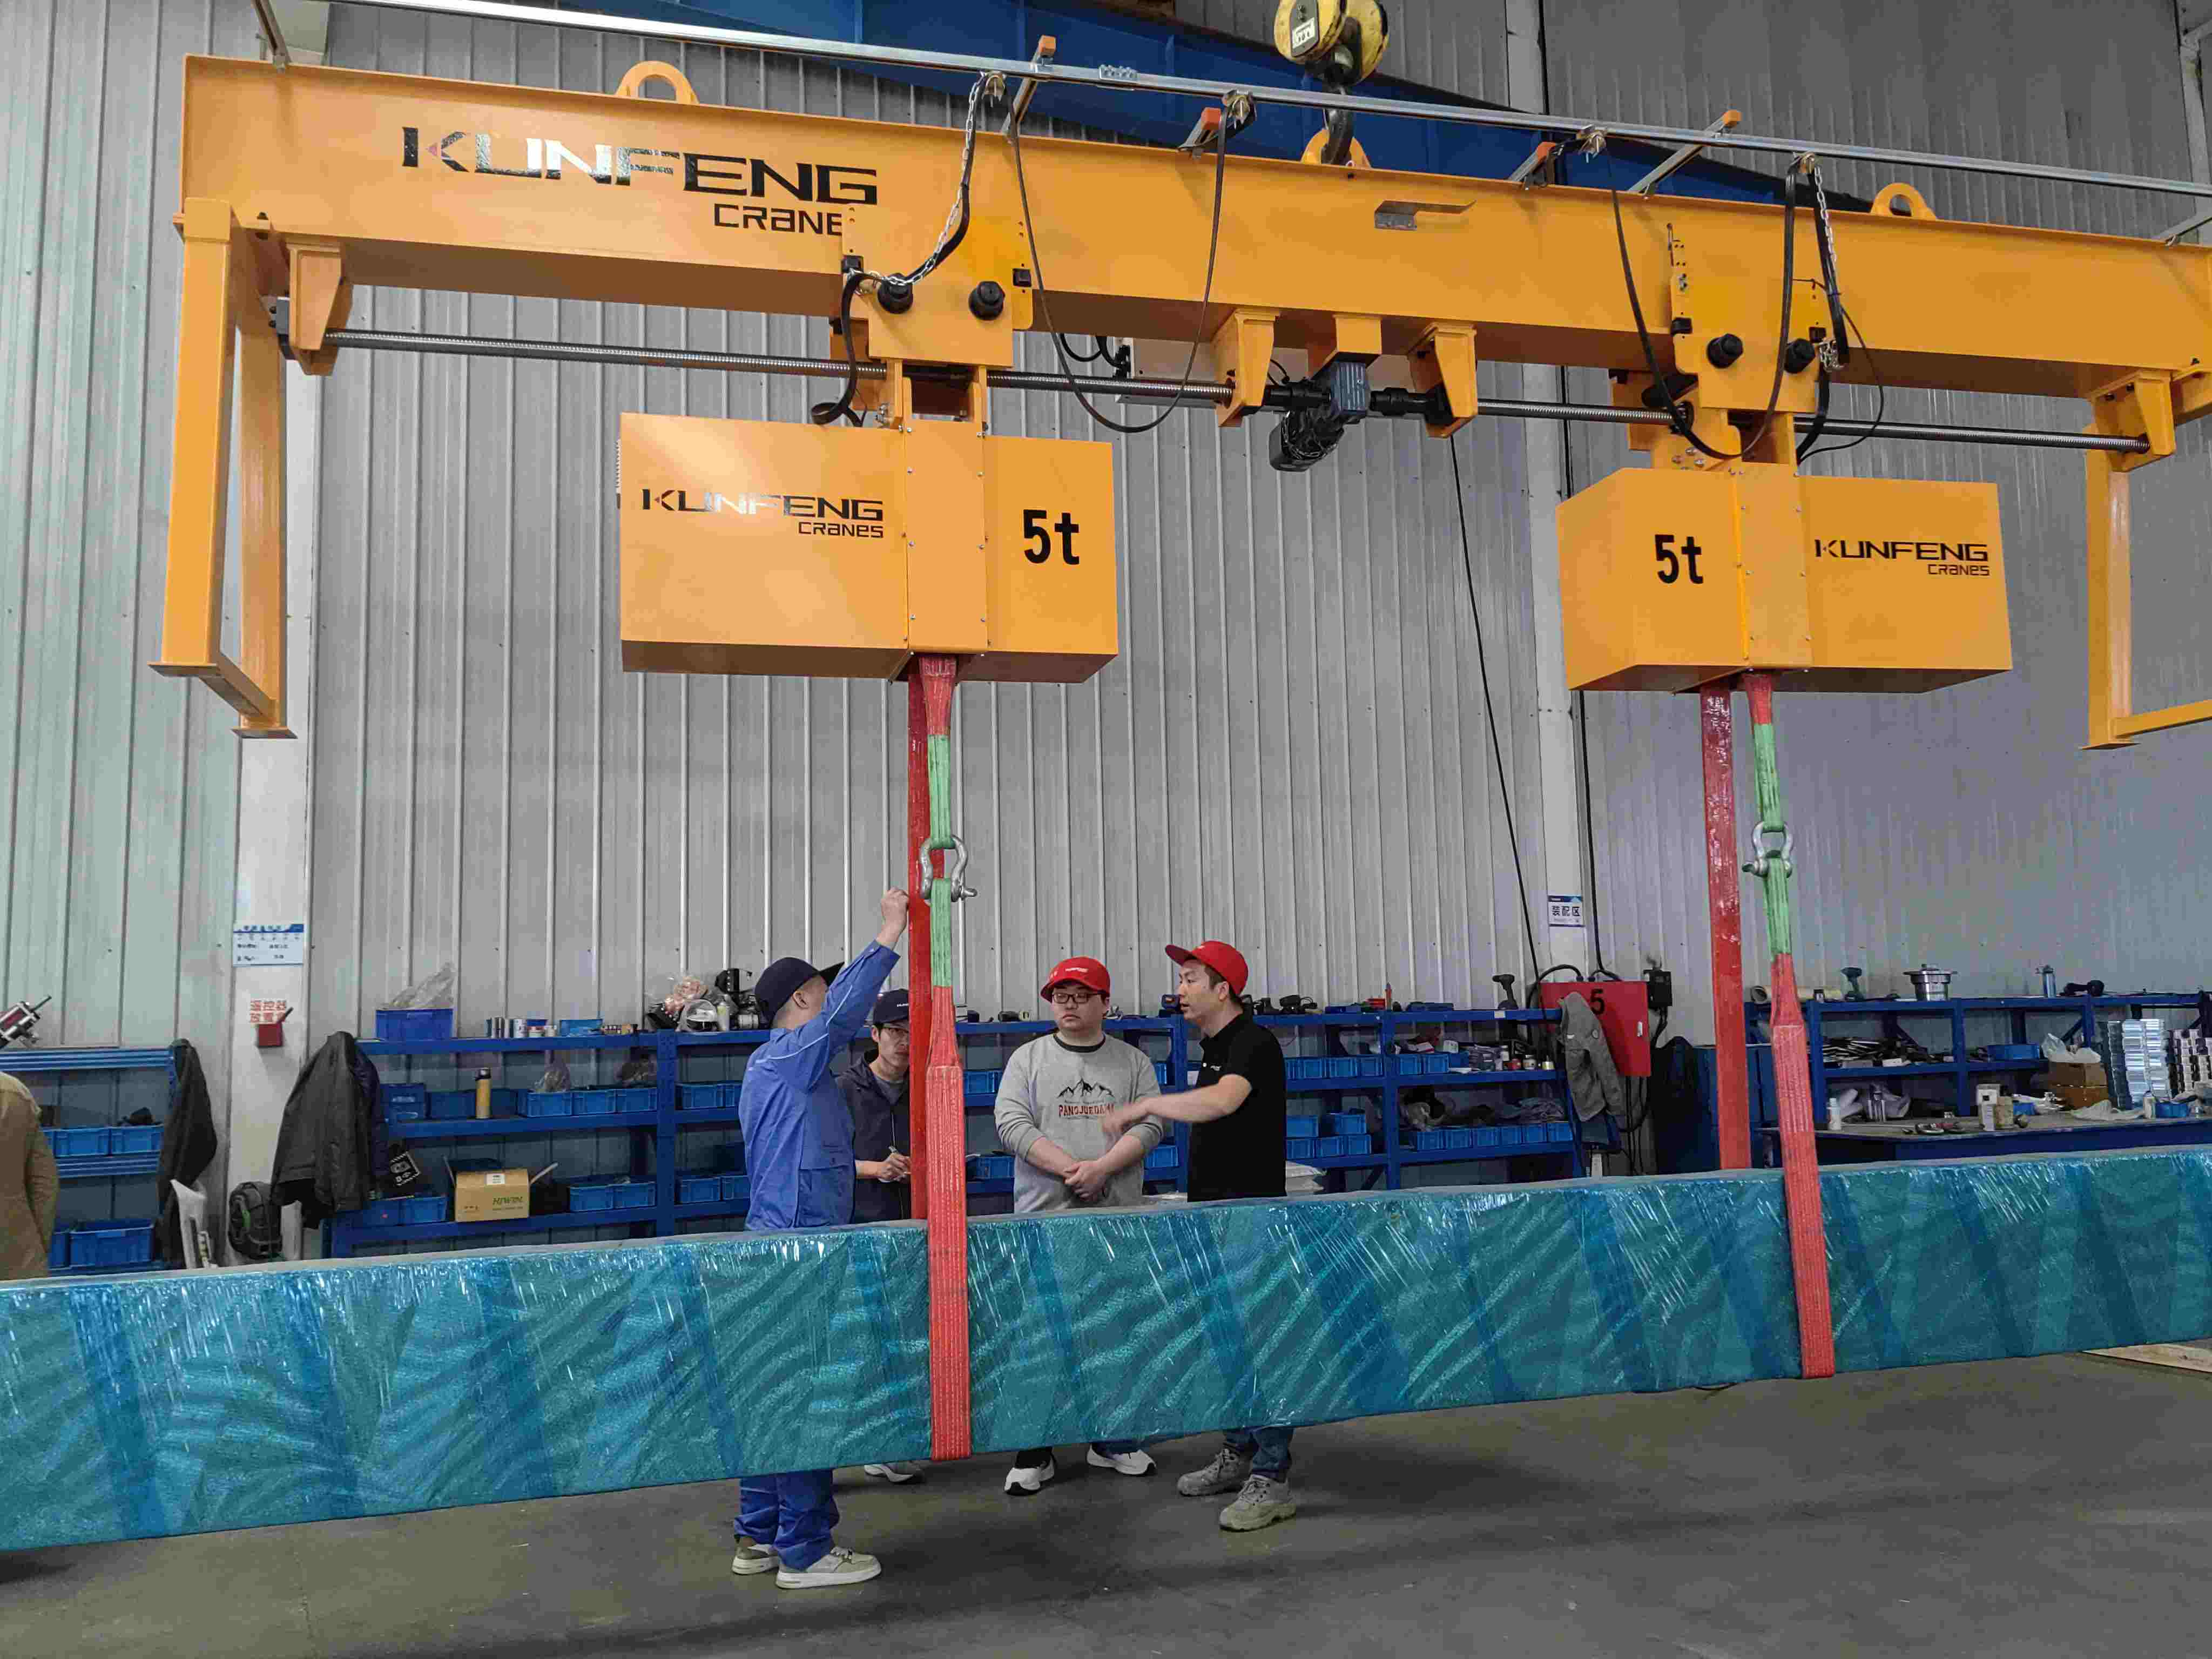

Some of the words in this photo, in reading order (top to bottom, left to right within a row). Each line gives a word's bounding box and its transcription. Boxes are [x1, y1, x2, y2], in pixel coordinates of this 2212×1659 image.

[402, 126, 878, 205] KUNFENG
[714, 203, 842, 237] CRANE
[642, 488, 884, 522] KUNFENG
[1023, 509, 1080, 565] 5t
[1815, 539, 1988, 562] KUNFENG
[1654, 534, 1704, 585] 5t
[1590, 988, 1605, 1015] 5
